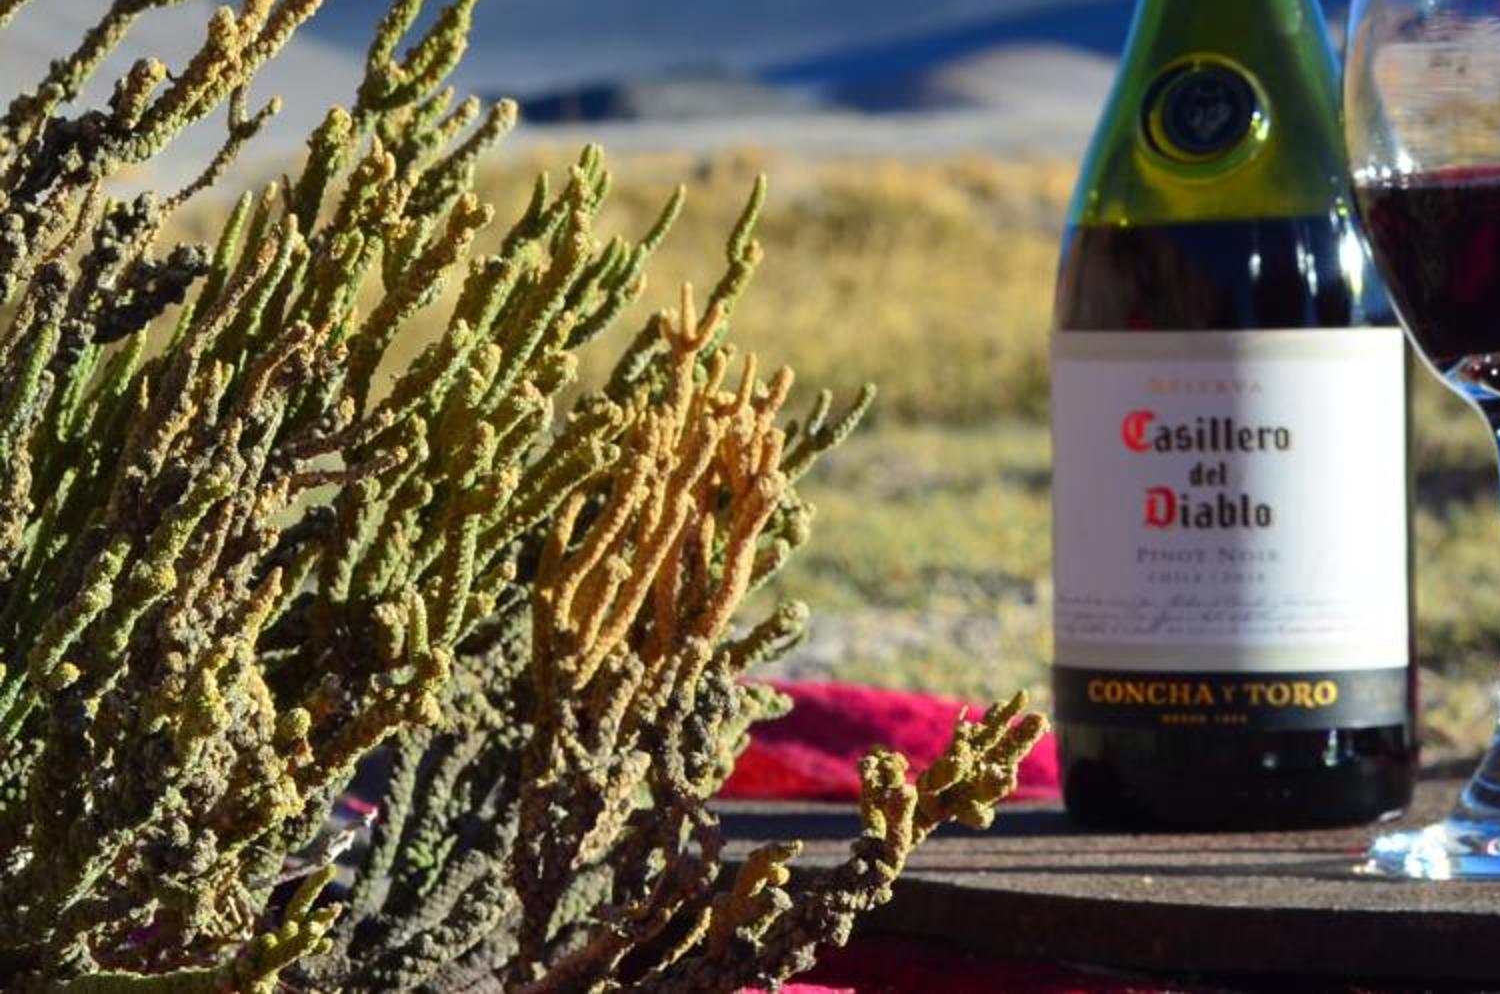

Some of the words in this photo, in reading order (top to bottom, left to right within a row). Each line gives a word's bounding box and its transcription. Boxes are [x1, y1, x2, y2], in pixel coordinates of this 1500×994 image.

[1121, 409, 1290, 452] Casillero
[1189, 462, 1227, 487] del
[1144, 486, 1272, 529] Diablo
[1088, 679, 1214, 705] CONCHA
[1244, 680, 1338, 708] TORO
